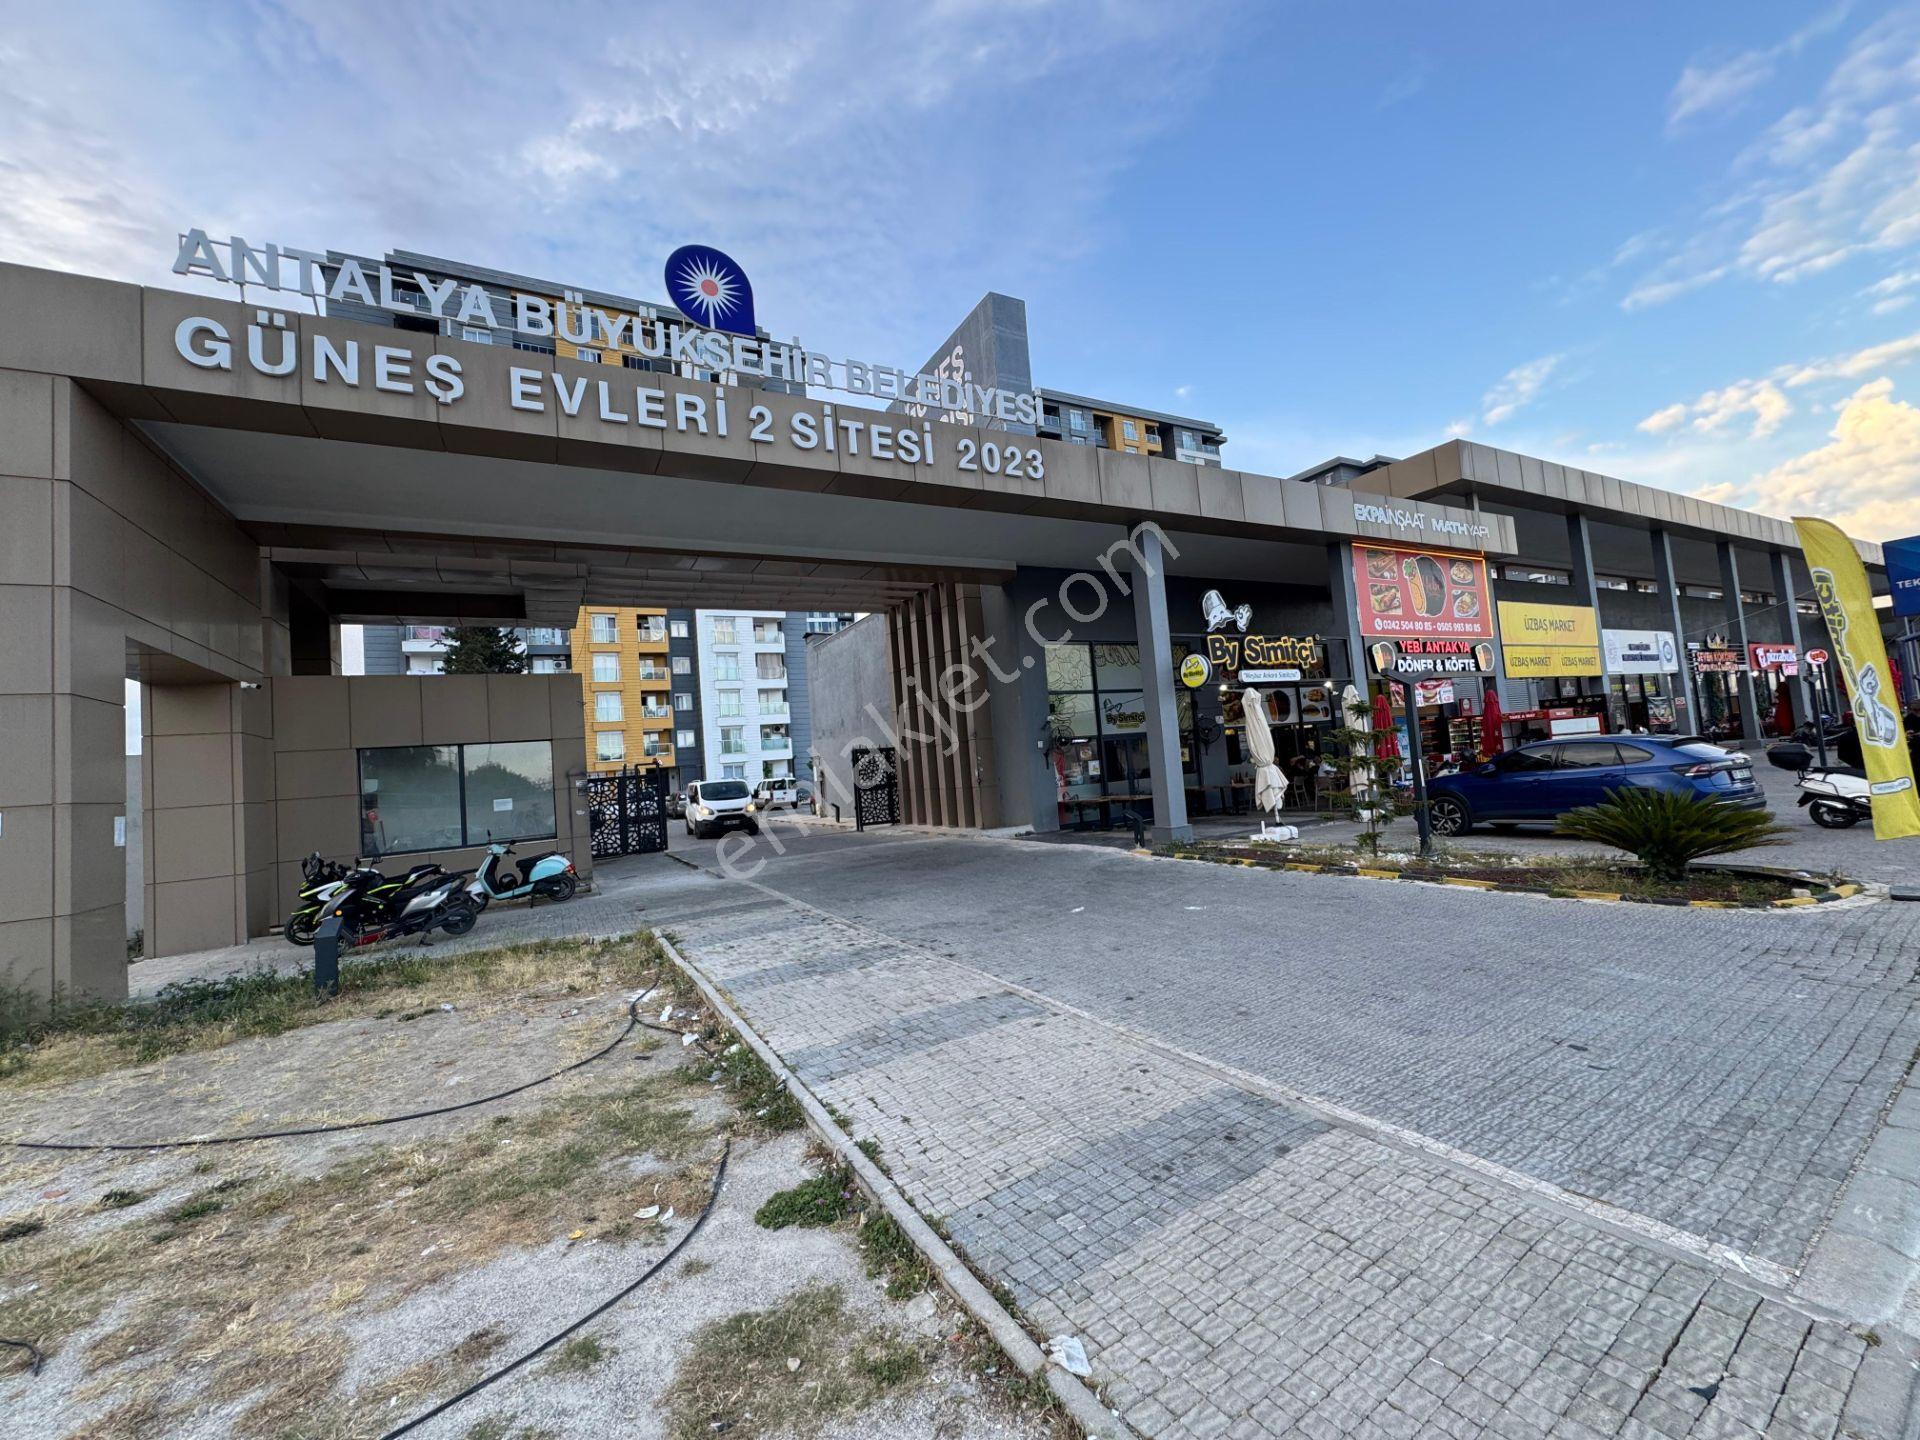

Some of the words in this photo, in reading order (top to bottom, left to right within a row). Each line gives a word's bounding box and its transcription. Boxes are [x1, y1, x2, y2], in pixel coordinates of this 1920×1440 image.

[172, 228, 498, 328] ANTALYA
[846, 358, 1044, 427] BELEDİYESİ
[174, 309, 465, 405] GÜNEŞ
[510, 366, 728, 437] EVLERİ
[749, 405, 774, 443] 2
[790, 404, 934, 465] SİTESİ
[957, 438, 1045, 480] 2023
[1549, 619, 1576, 632] MARKET
[1207, 635, 1239, 670] By
[1244, 635, 1317, 669] Simitçi
[1399, 638, 1424, 653] YEBİ
[1426, 641, 1471, 654] ANTAKYA
[1435, 660, 1444, 672] &
[1444, 656, 1476, 672] KÖFTE
